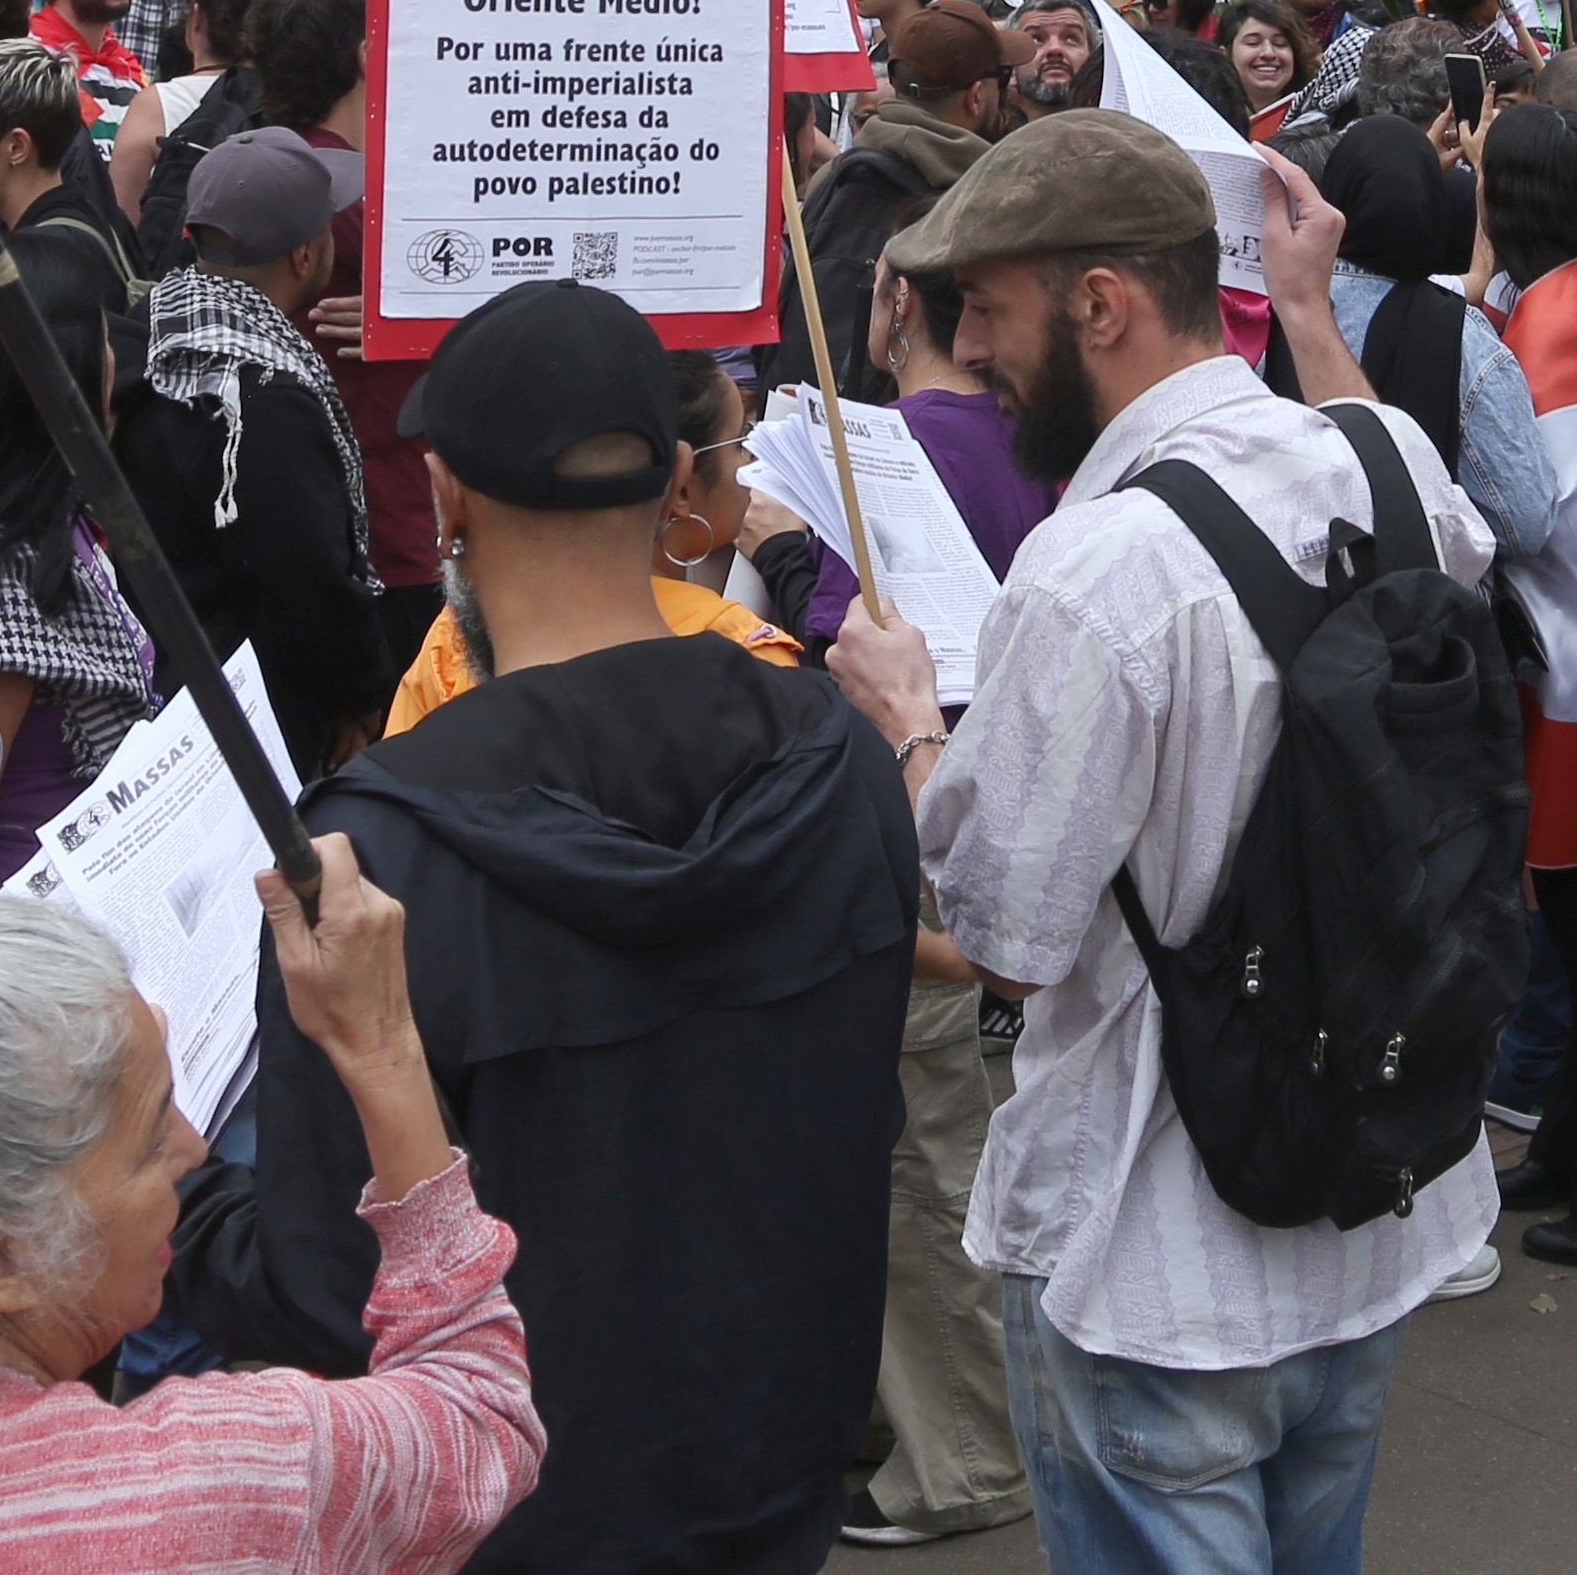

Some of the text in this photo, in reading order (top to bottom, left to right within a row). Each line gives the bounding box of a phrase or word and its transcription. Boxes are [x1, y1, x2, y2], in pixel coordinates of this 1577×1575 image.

[437, 36, 723, 62] Por uma frente única
[468, 70, 692, 102] anti-imperialista
[491, 105, 668, 128] em defesa da
[433, 137, 719, 169] autodeterminação do
[473, 171, 681, 203] povo palestino!
[492, 237, 553, 257] POR
[105, 734, 195, 815] MASSAS
